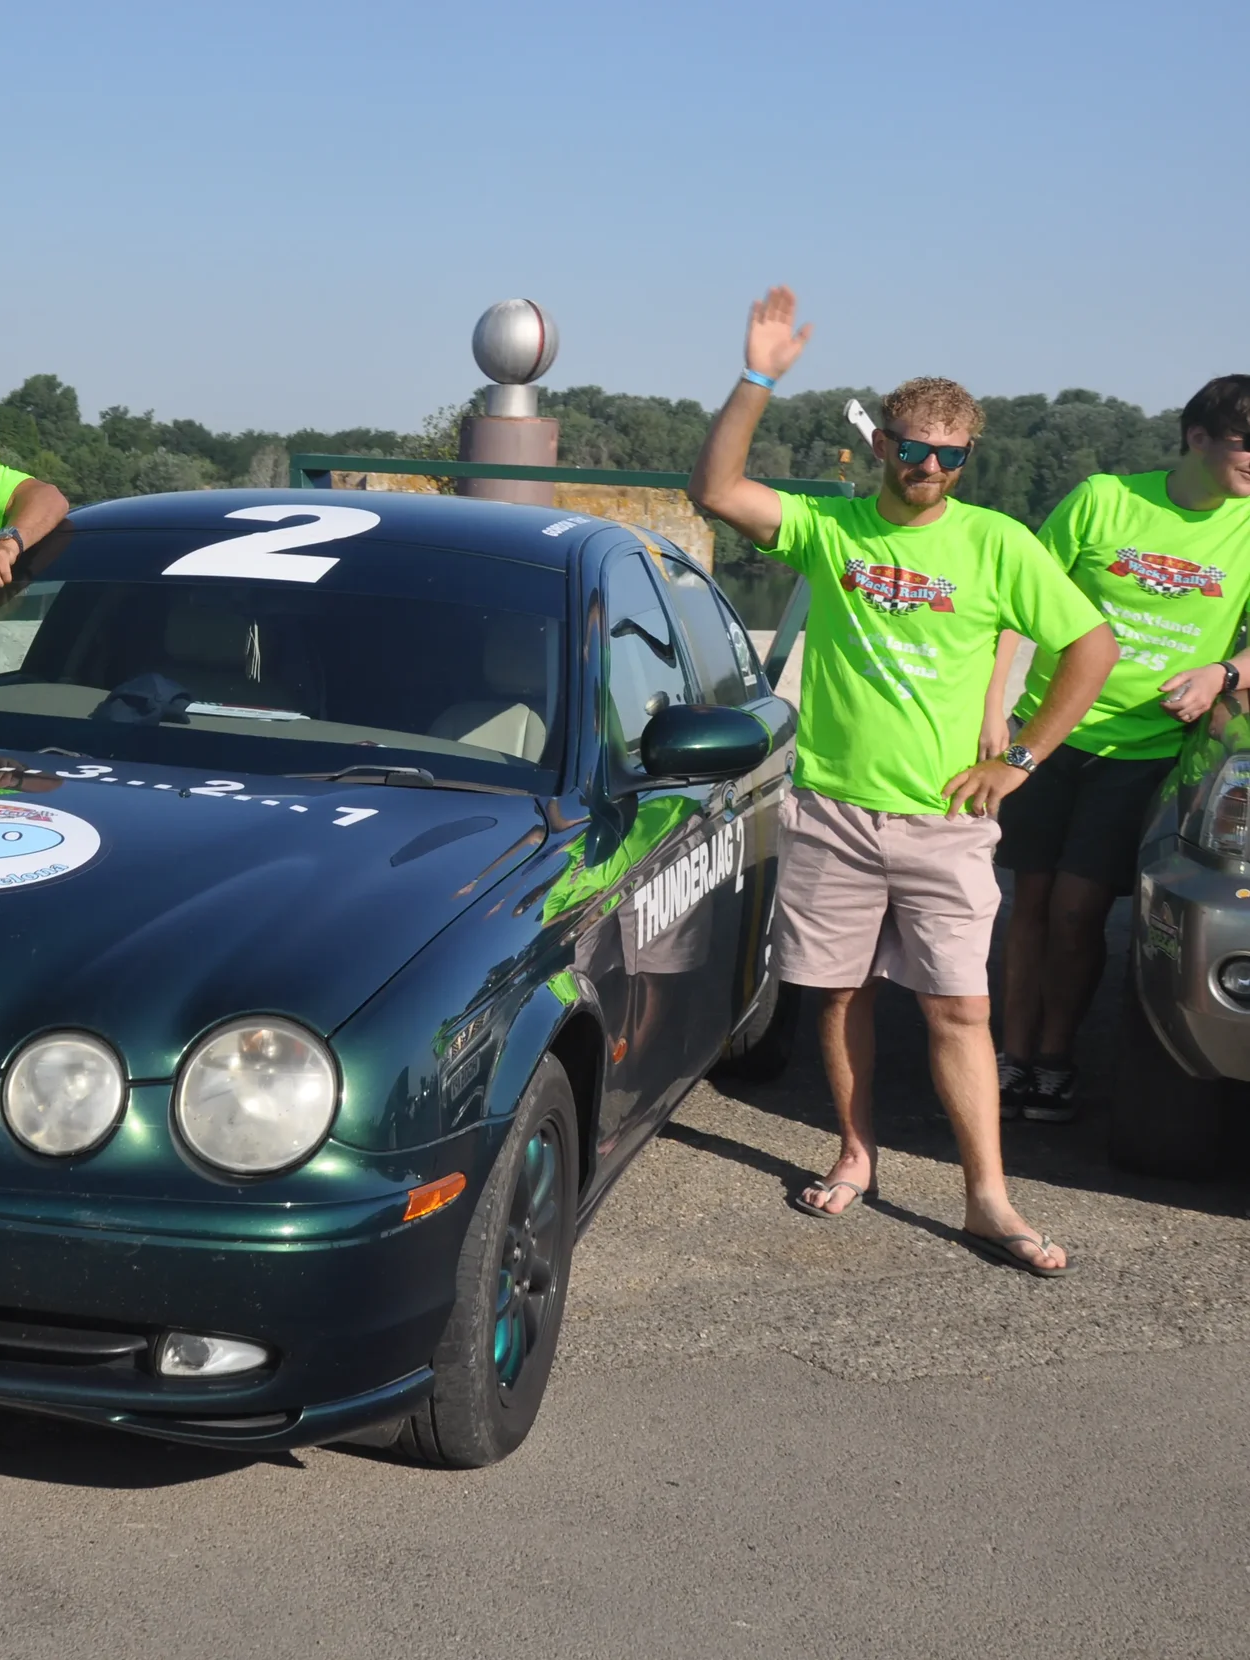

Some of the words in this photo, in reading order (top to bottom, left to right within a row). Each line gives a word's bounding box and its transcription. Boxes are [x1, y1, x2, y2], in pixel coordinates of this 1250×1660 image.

[161, 504, 381, 583] 2
[854, 571, 897, 597] Wacky
[899, 586, 937, 601] Rally
[1128, 561, 1169, 581] Wacky
[1173, 573, 1208, 586] Rally
[332, 806, 380, 827] 1
[634, 823, 734, 950] THUNDERJAG
[735, 816, 745, 894] 2
